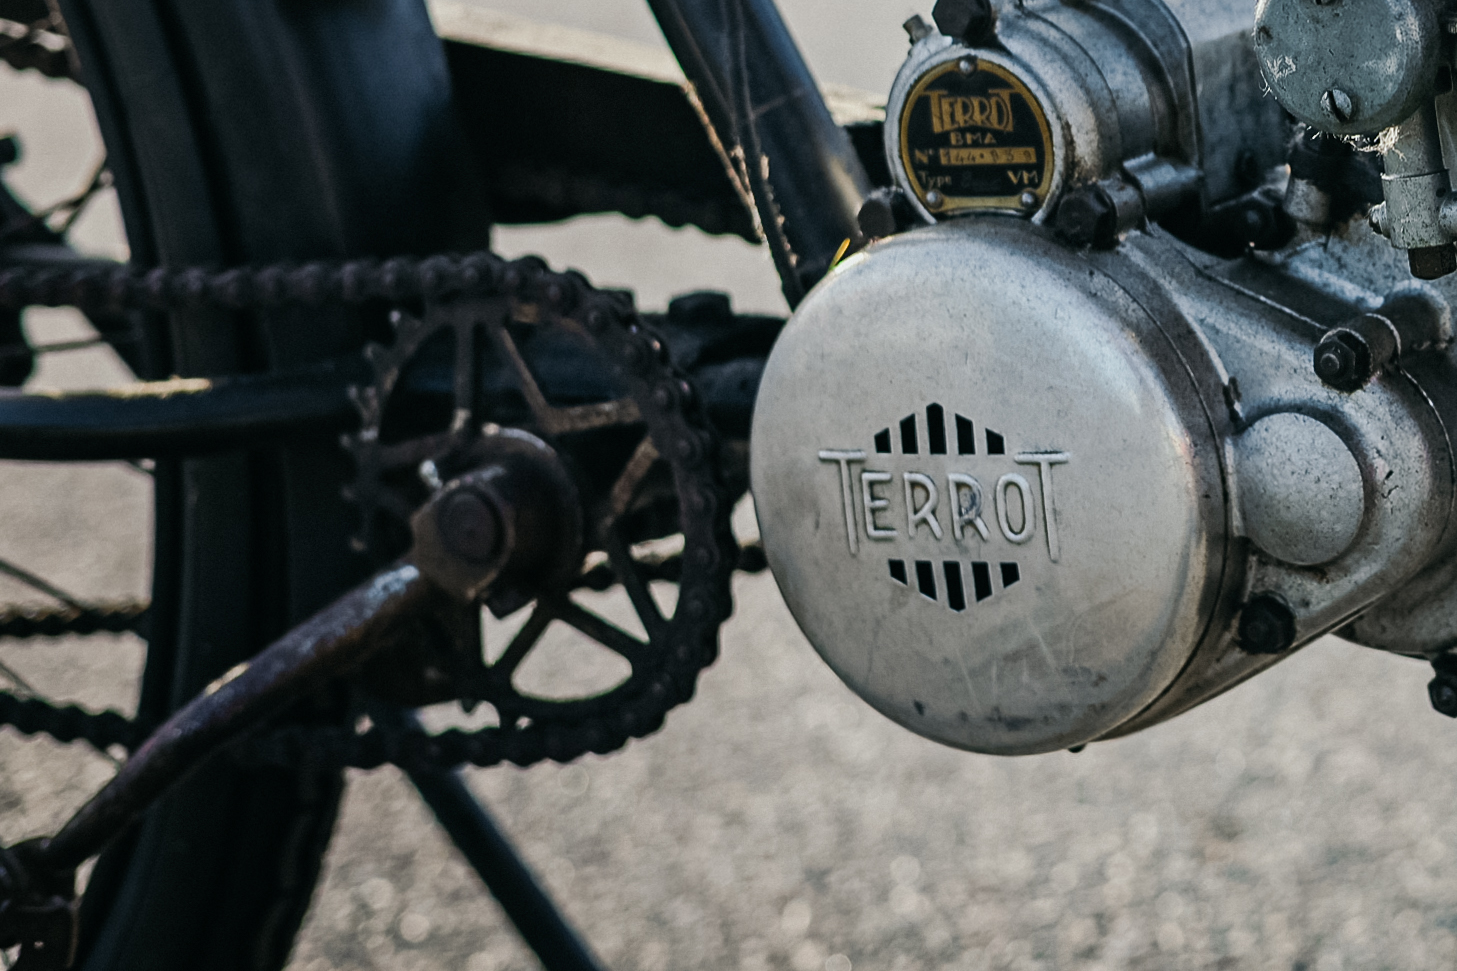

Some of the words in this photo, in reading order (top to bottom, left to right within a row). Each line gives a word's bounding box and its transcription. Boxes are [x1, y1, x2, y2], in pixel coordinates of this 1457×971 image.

[920, 89, 1016, 134] TERROT
[950, 131, 997, 146] BMA
[1006, 169, 1039, 185] VM
[818, 448, 1072, 564] TERROT
